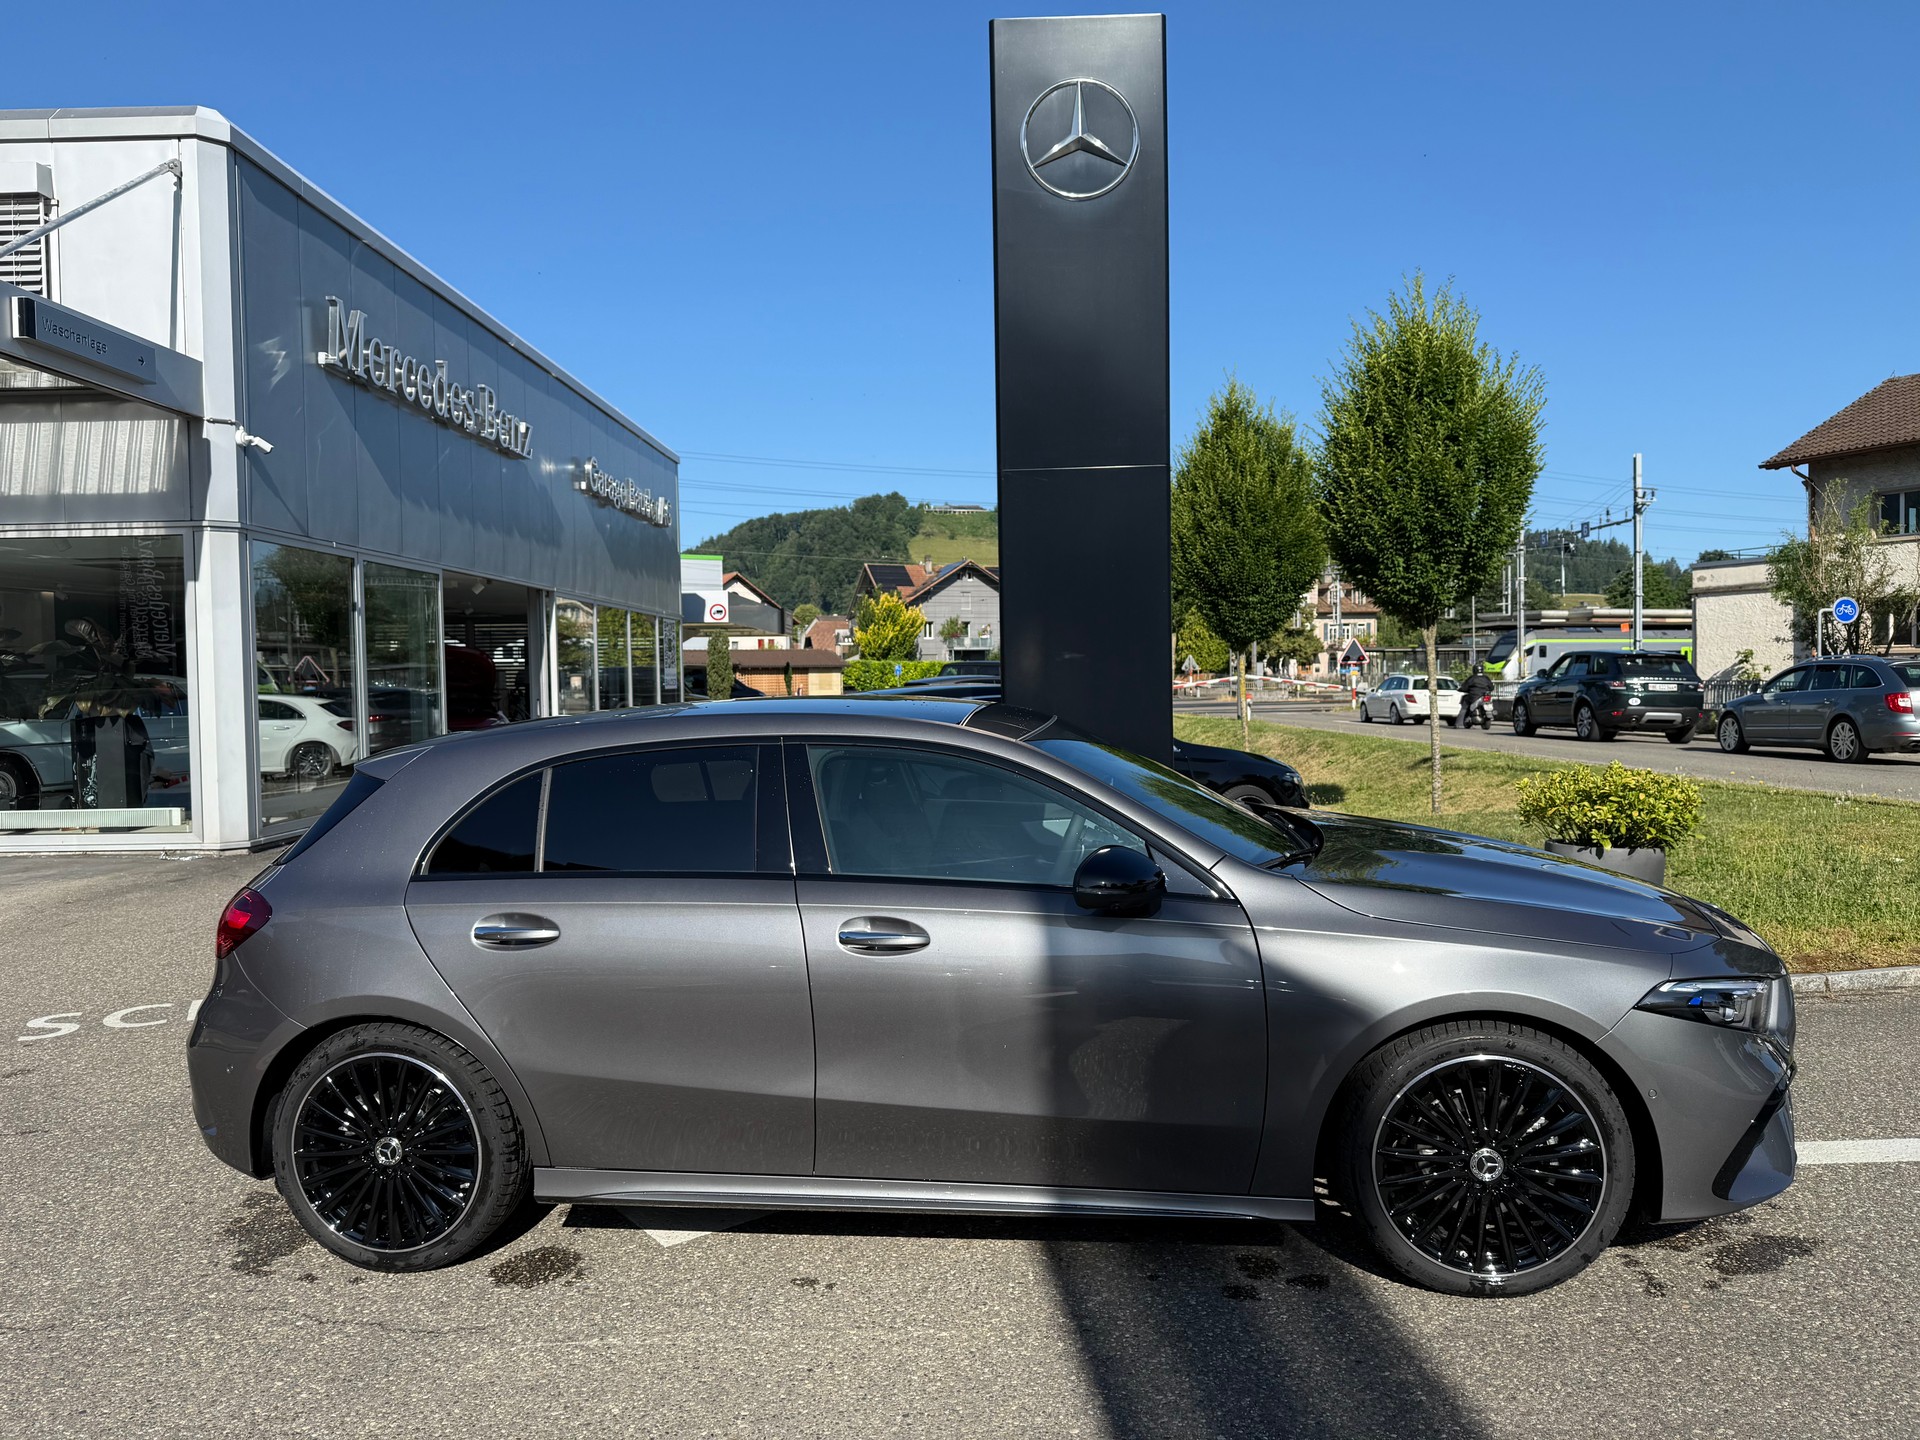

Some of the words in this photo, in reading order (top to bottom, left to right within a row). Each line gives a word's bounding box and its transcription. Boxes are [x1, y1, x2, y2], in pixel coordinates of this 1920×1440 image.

[42, 316, 108, 354] Waschanlage
[318, 295, 534, 460] Mercedes-Benz
[585, 456, 627, 509] Garage
